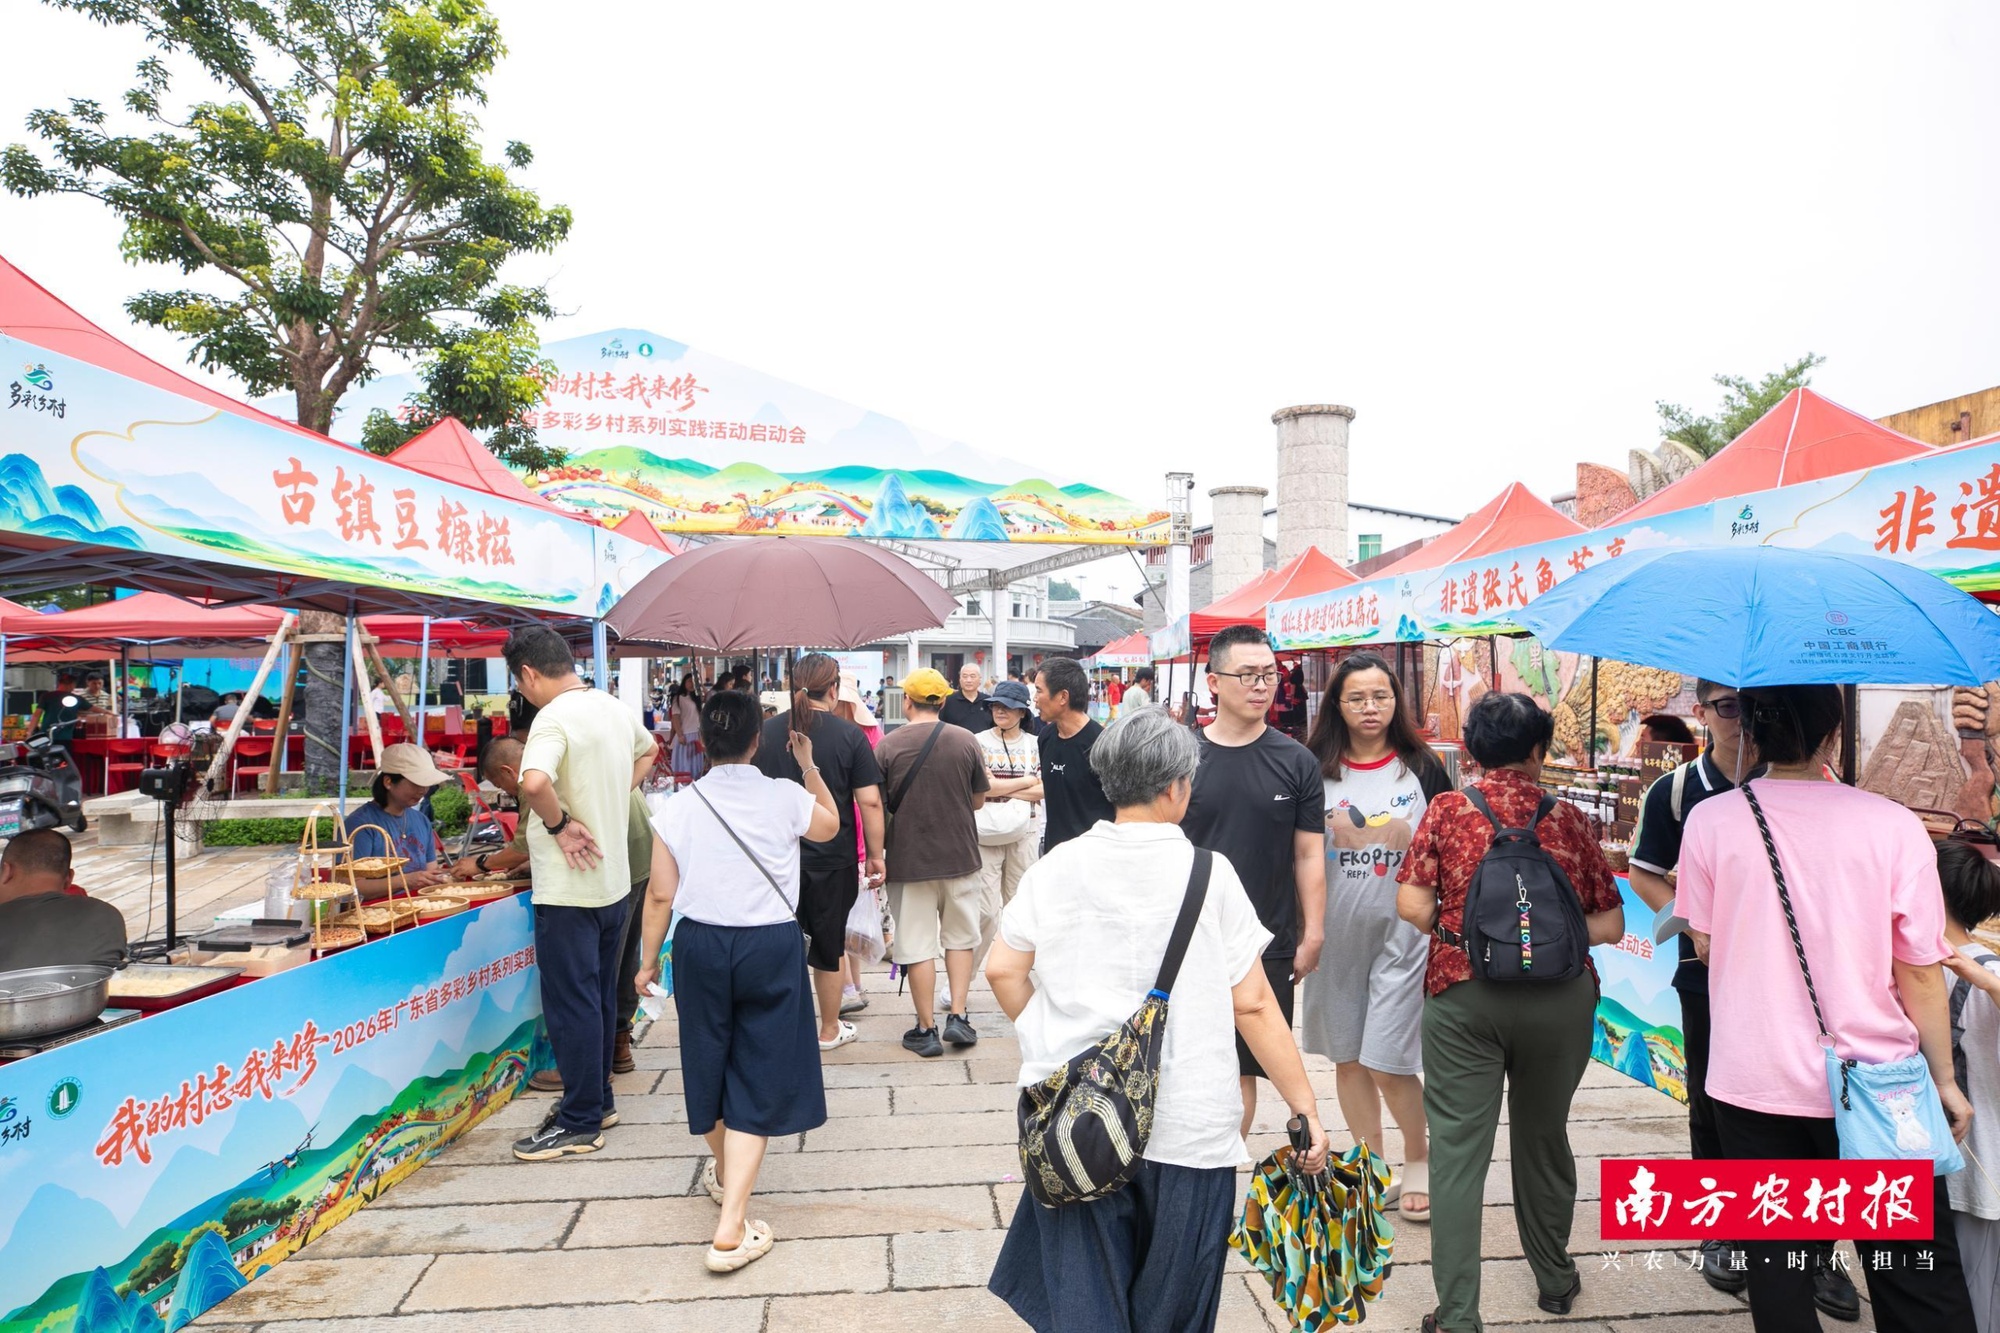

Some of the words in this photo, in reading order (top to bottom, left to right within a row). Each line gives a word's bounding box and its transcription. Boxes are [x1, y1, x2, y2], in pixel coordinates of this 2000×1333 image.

[8, 381, 67, 419] 多彩乡村
[505, 411, 806, 444] 省多彩乡村系列实践活动启动会
[1826, 628, 1857, 636] ICBC
[1803, 641, 1888, 651] 中国工商银行
